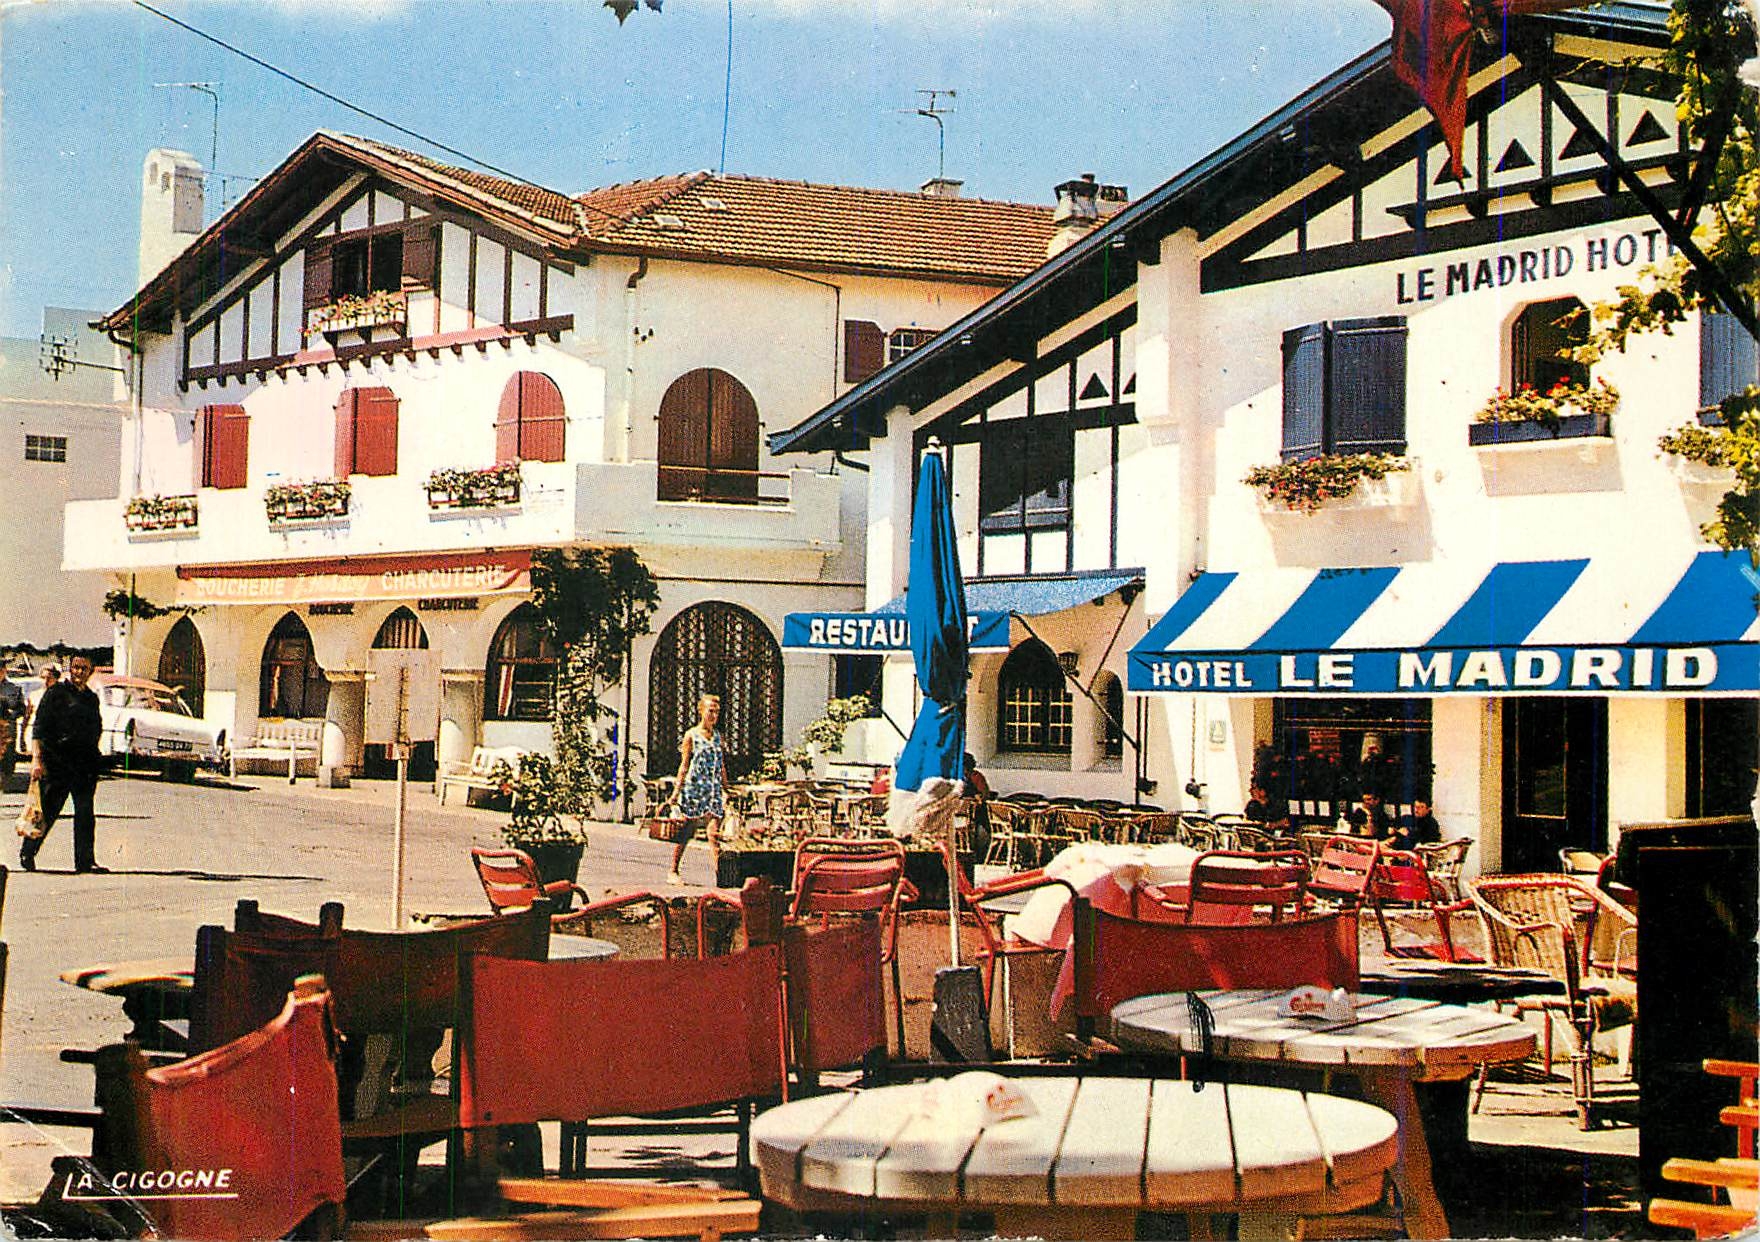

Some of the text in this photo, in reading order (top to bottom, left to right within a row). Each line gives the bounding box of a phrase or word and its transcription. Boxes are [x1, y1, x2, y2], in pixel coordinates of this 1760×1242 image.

[1396, 267, 1435, 305] LE
[1445, 245, 1574, 296] MADRID
[193, 577, 286, 597] BOUCHERIE
[381, 564, 507, 591] CHARCUTERIE
[1151, 660, 1252, 688] HOTEL
[1279, 647, 1719, 688] LE MADRID
